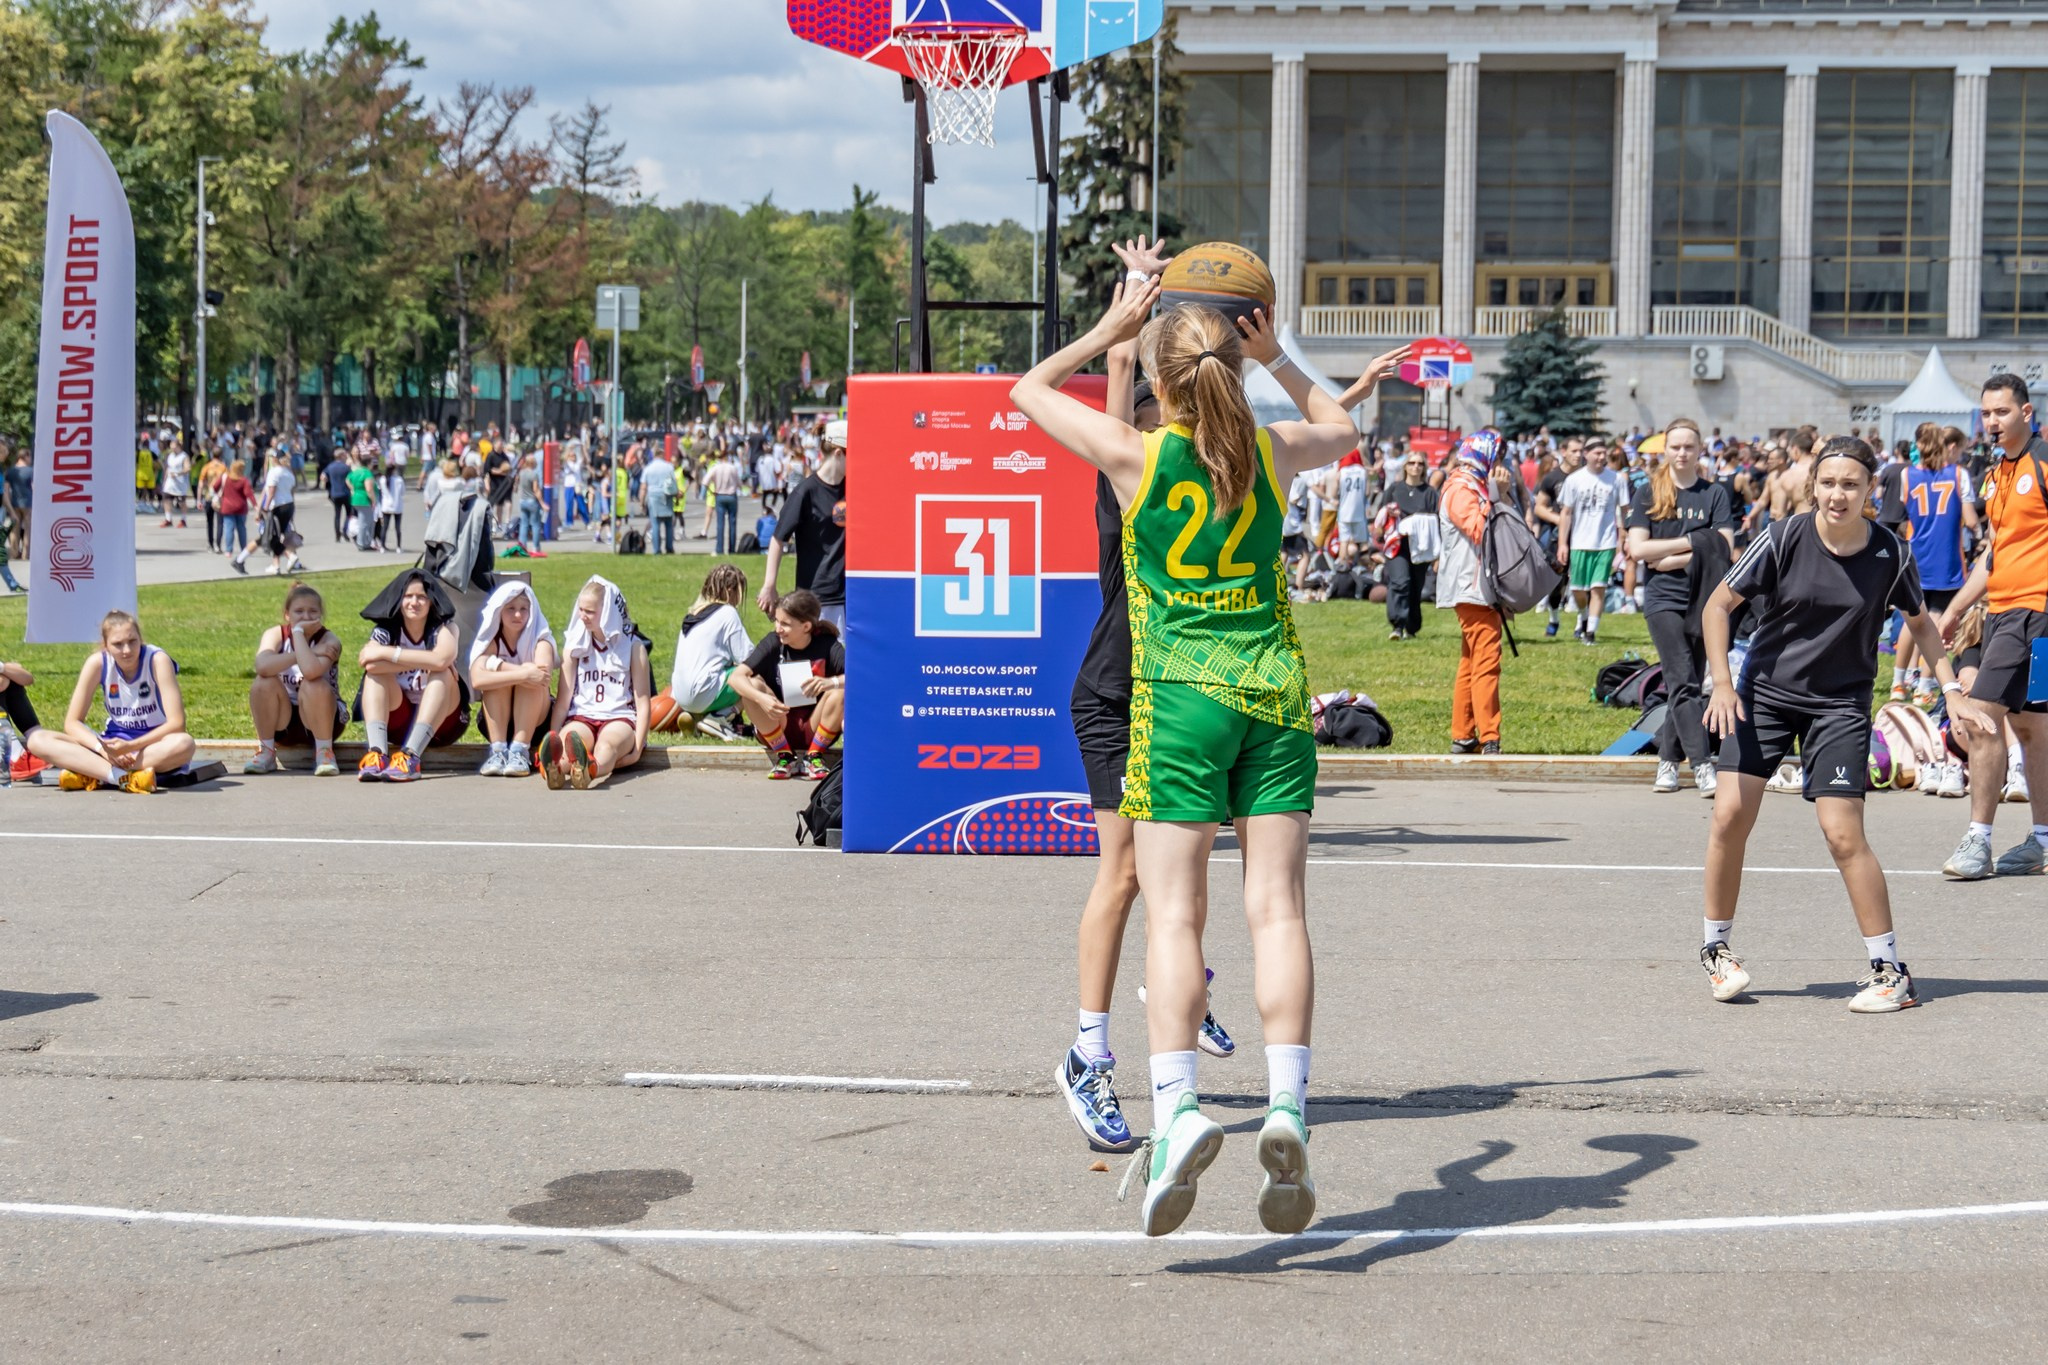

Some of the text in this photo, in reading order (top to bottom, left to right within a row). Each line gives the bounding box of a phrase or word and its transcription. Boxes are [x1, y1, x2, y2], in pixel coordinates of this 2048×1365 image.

[1006, 421, 1027, 431] СПОРТ
[1345, 477, 1361, 492] 24
[1910, 480, 1955, 516] 17
[1166, 481, 1257, 579] 22
[944, 519, 1009, 615] 31
[921, 665, 1038, 675] 100.MOSCOW.SPORT
[595, 684, 605, 703] 8
[926, 686, 1033, 696] STREETBASKET.RU
[918, 706, 1056, 717] @STREETBASKETRUSSIA
[918, 744, 1041, 770] 2023
